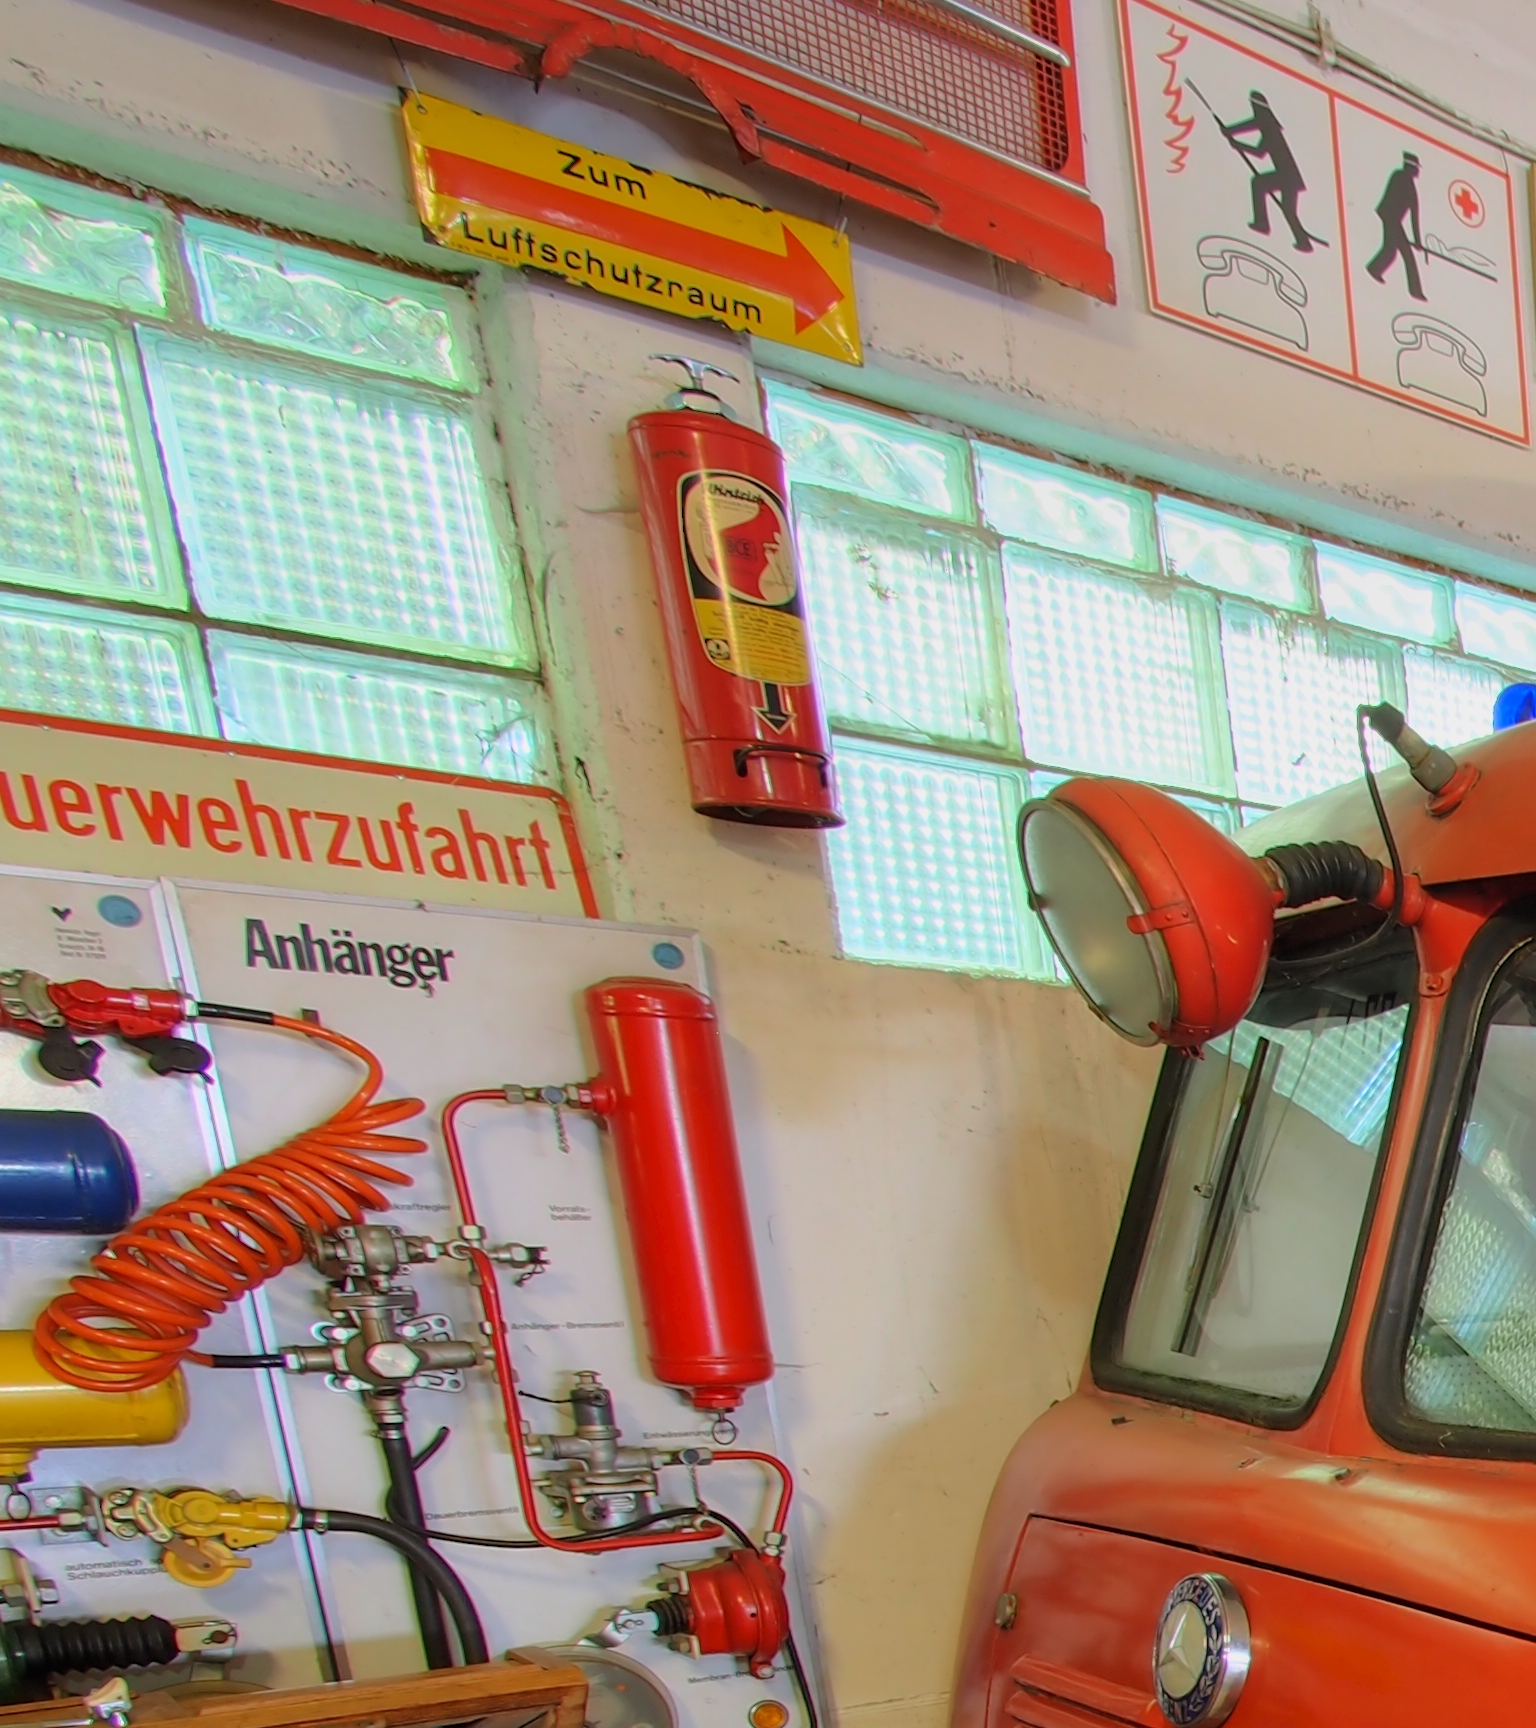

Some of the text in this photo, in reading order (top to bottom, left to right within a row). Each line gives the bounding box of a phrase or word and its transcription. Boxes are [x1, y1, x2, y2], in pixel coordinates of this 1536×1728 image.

[557, 149, 647, 200] Zum
[460, 211, 762, 324] Luftschutzraum
[0, 770, 558, 890] uerwehrzufahrt
[244, 916, 456, 988] Anhänger
